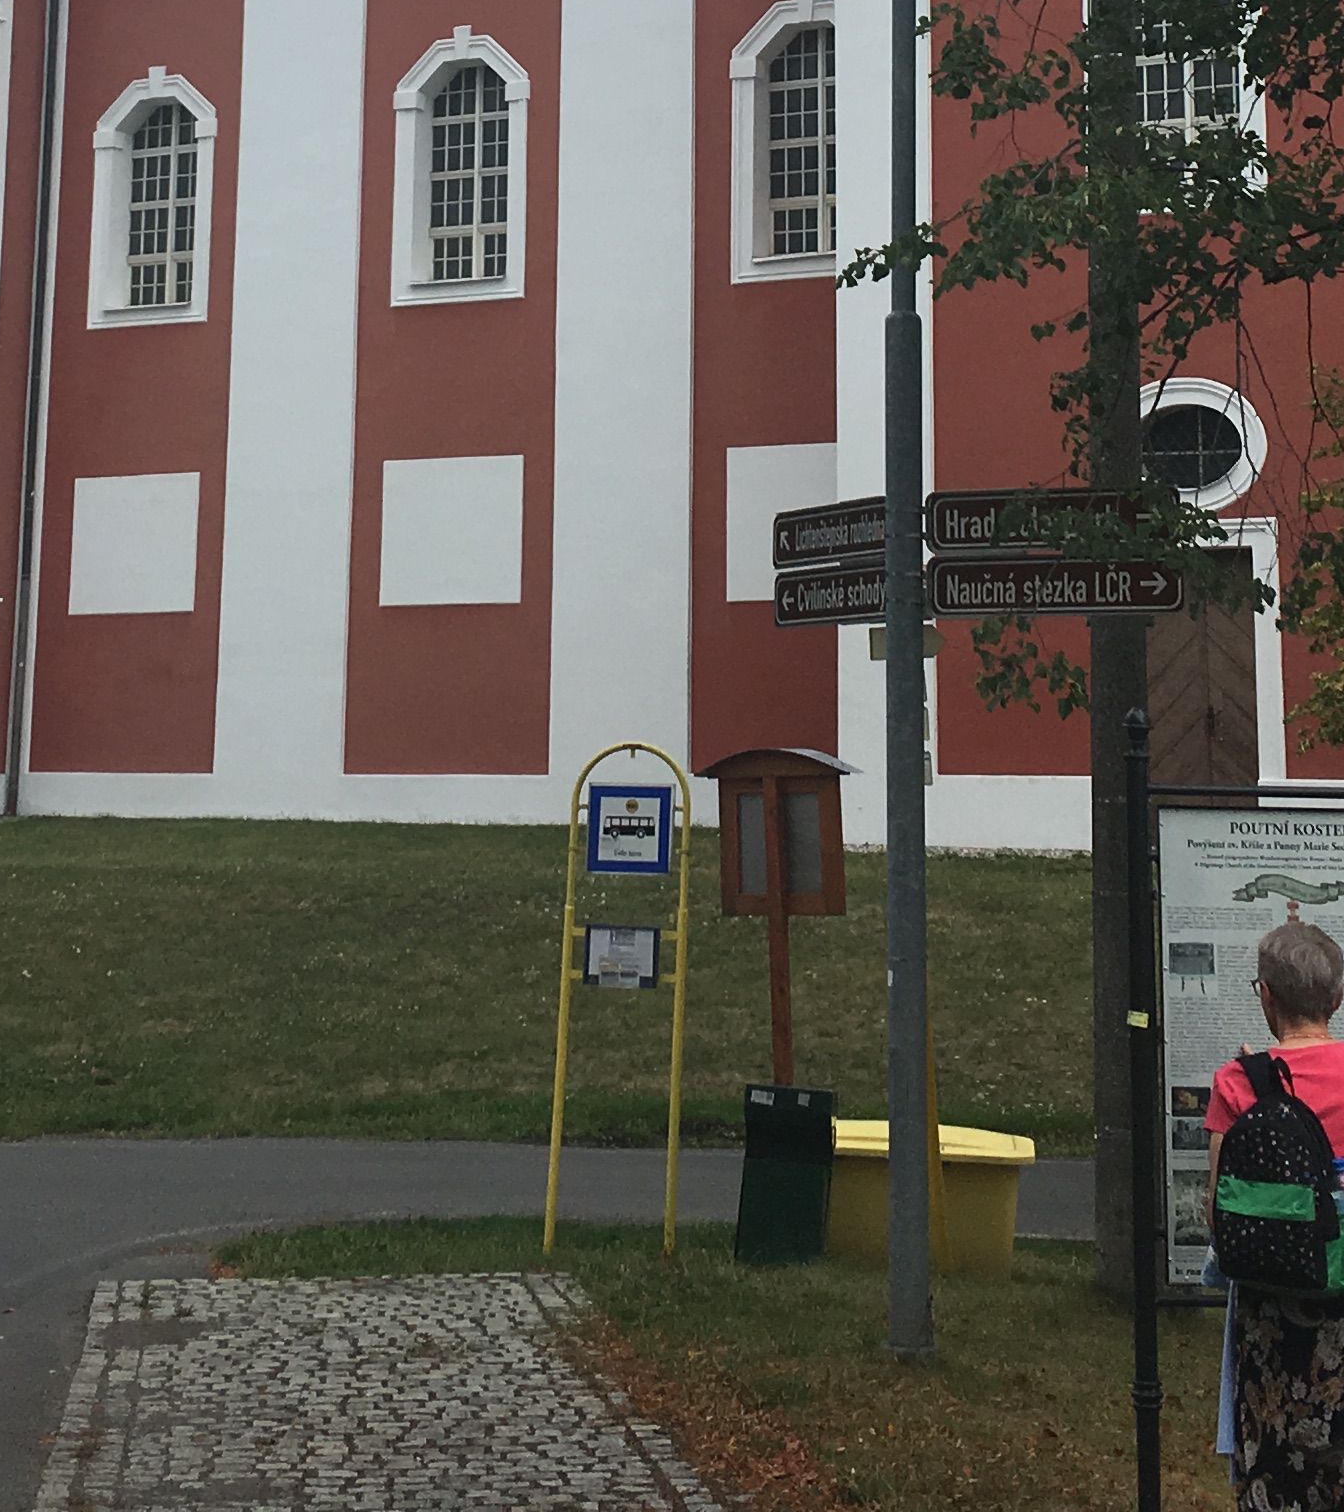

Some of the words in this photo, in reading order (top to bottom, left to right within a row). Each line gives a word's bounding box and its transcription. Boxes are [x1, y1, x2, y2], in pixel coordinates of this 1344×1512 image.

[945, 507, 996, 539] Hrad
[848, 574, 885, 611] schody
[946, 572, 1016, 605] Naučná
[1023, 572, 1087, 603] stezka
[1095, 564, 1132, 602] LČR
[1230, 820, 1289, 836] POUTNÍ
